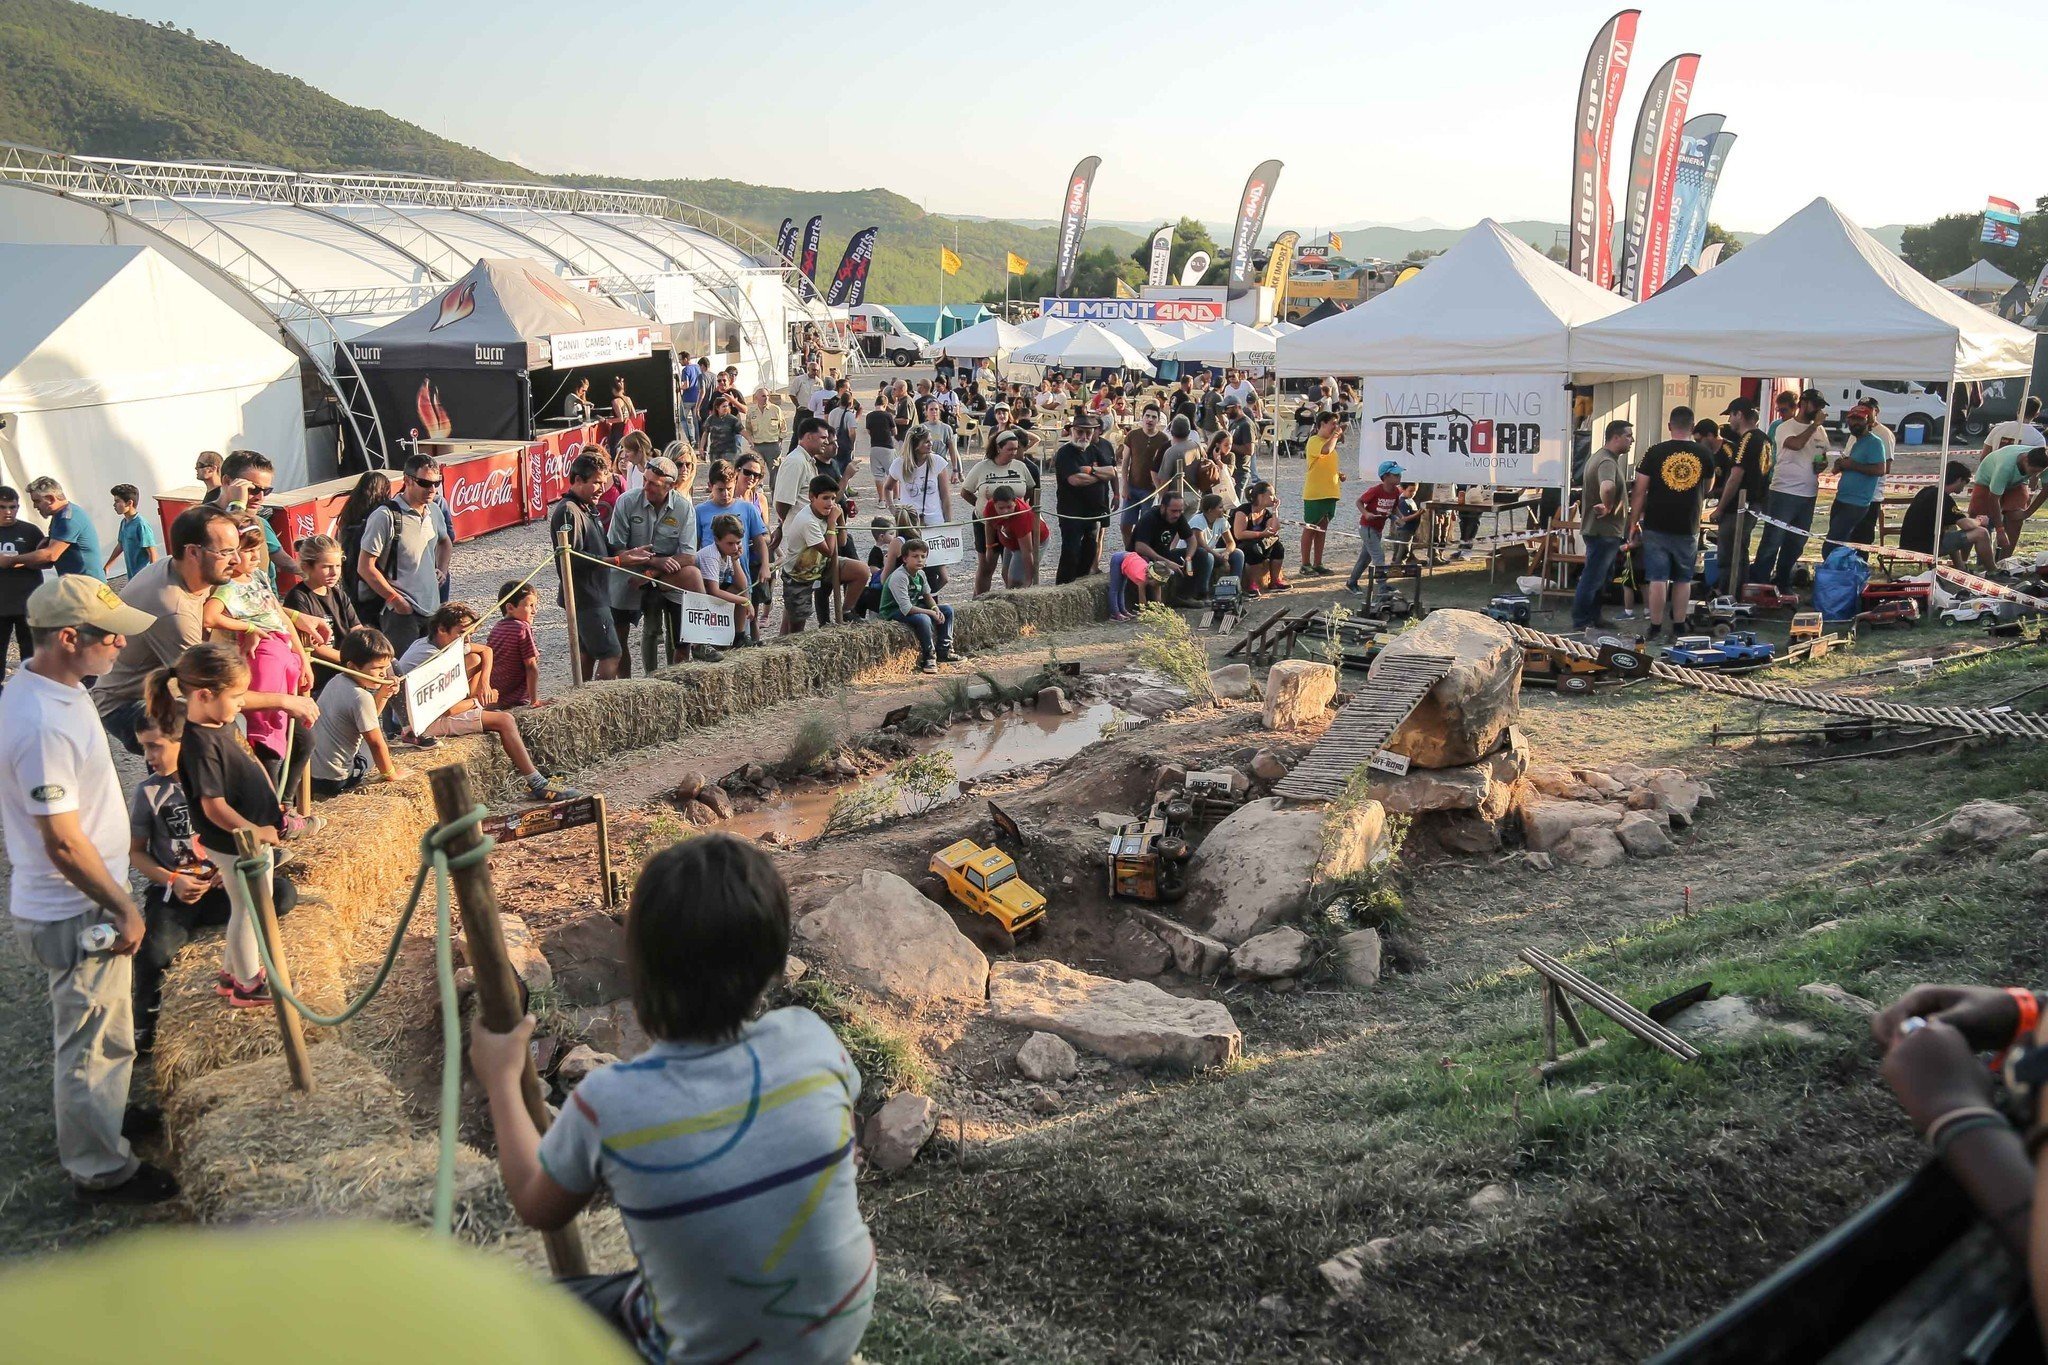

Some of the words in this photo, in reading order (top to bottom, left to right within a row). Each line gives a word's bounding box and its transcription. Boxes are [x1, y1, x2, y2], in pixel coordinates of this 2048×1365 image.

[1151, 252, 1161, 286] NIBAL
[1158, 254, 1167, 286] QUIPMENT
[1275, 247, 1288, 276] IMPORT
[1649, 221, 1664, 296] dventure
[1045, 301, 1156, 319] ALMONT
[353, 343, 381, 360] burn
[475, 343, 504, 360] burn
[1384, 391, 1542, 416] MARKETING
[1384, 418, 1541, 458] OFF-ROAD
[1472, 457, 1519, 468] MOORLY
[450, 467, 516, 517] Coca-Cola
[688, 611, 730, 627] OFF-ROAD
[416, 663, 461, 707] OFF-ROAD
